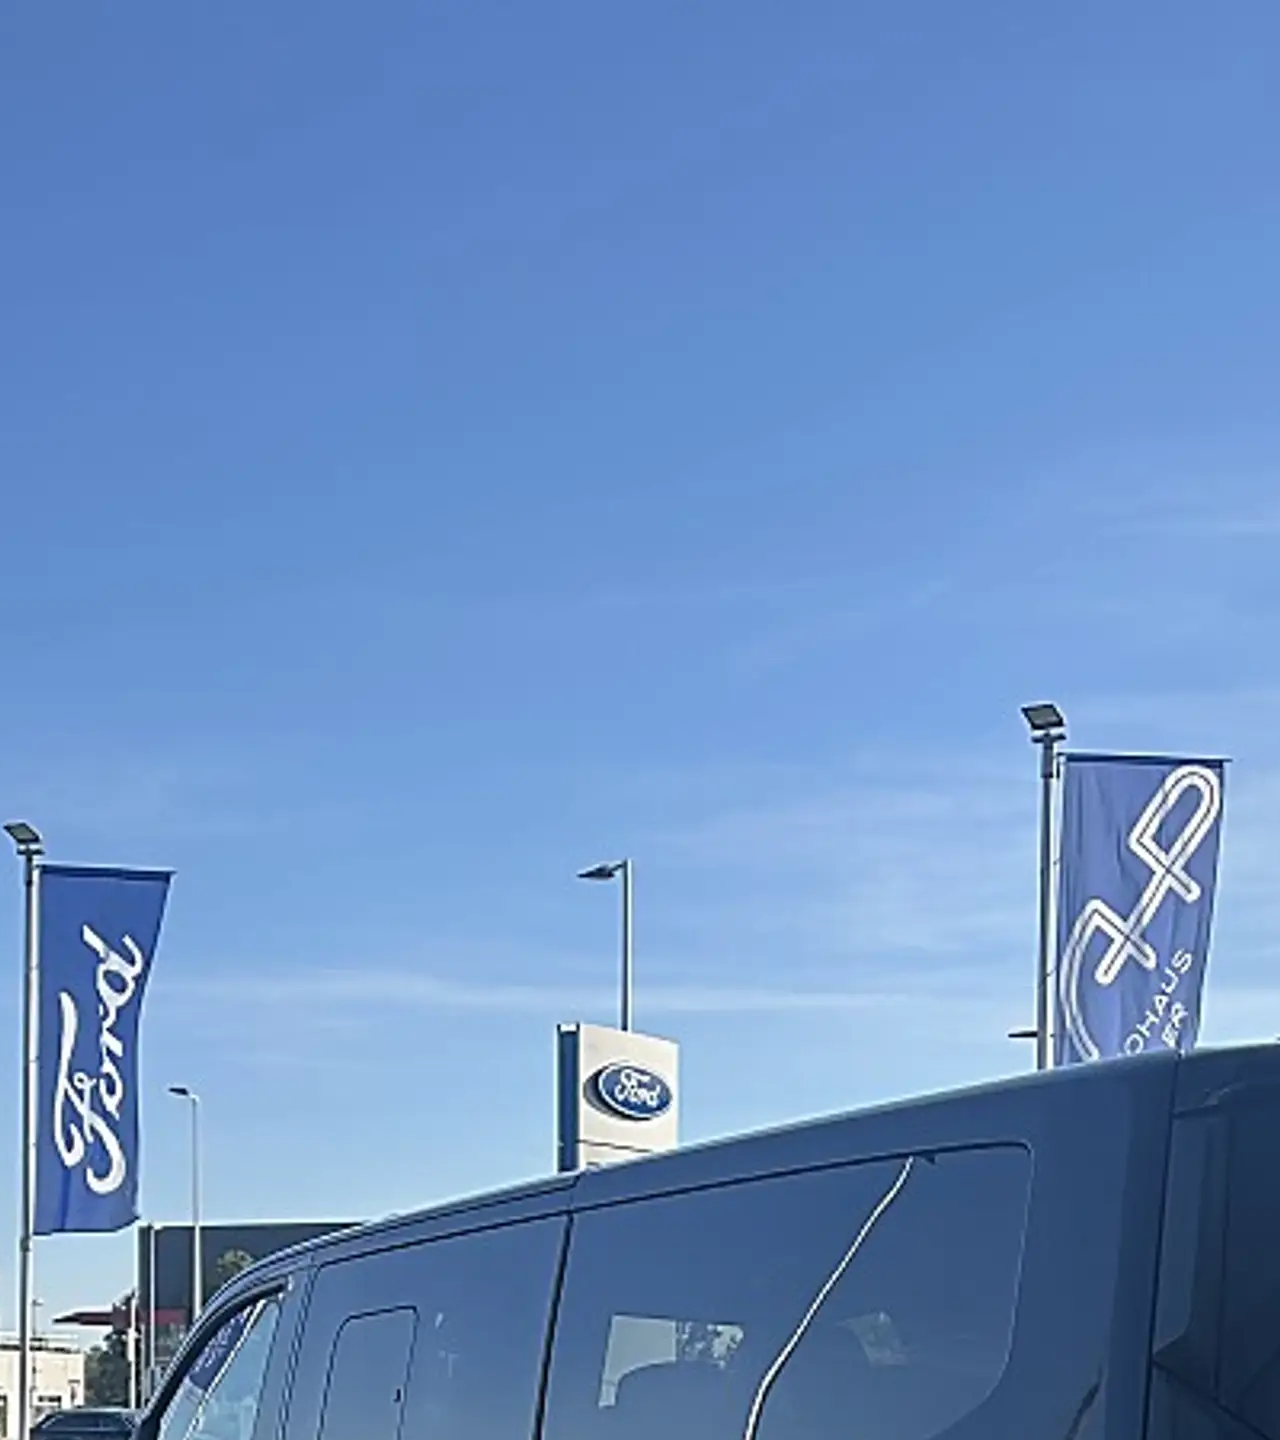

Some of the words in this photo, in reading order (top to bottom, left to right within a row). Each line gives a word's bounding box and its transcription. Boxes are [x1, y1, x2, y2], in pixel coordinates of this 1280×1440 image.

[1127, 948, 1193, 1056] OHAUS
[54, 924, 143, 1194] Ford
[613, 1069, 661, 1108] Ford
